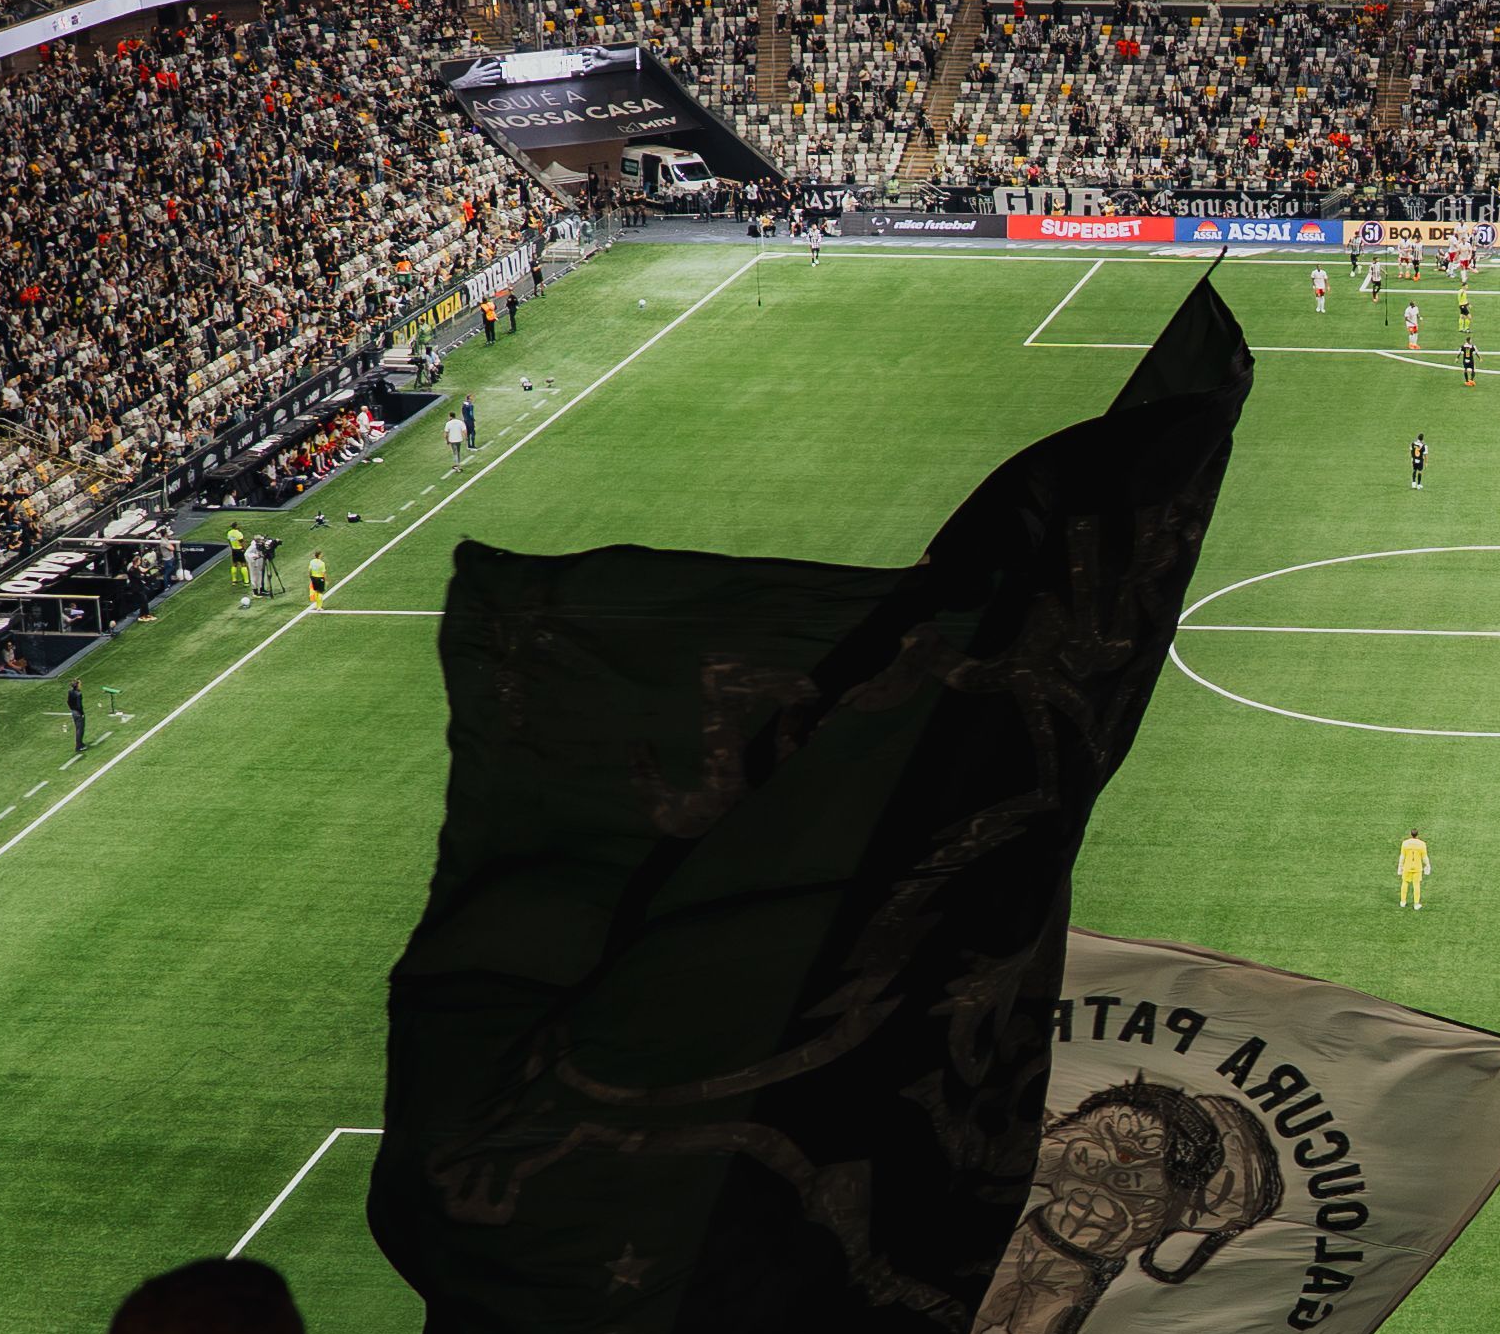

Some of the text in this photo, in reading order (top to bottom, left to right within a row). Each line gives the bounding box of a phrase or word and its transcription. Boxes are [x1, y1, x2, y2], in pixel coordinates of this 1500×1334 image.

[472, 88, 587, 114] AQUI É A
[488, 98, 665, 130] NOSSA CASA
[638, 116, 678, 130] MRV
[1150, 189, 1301, 219] Esquadrão
[924, 219, 978, 232] futebol
[1040, 219, 1142, 239] SUPERBET
[1364, 224, 1382, 242] 51
[1389, 227, 1457, 241] BOA IDE
